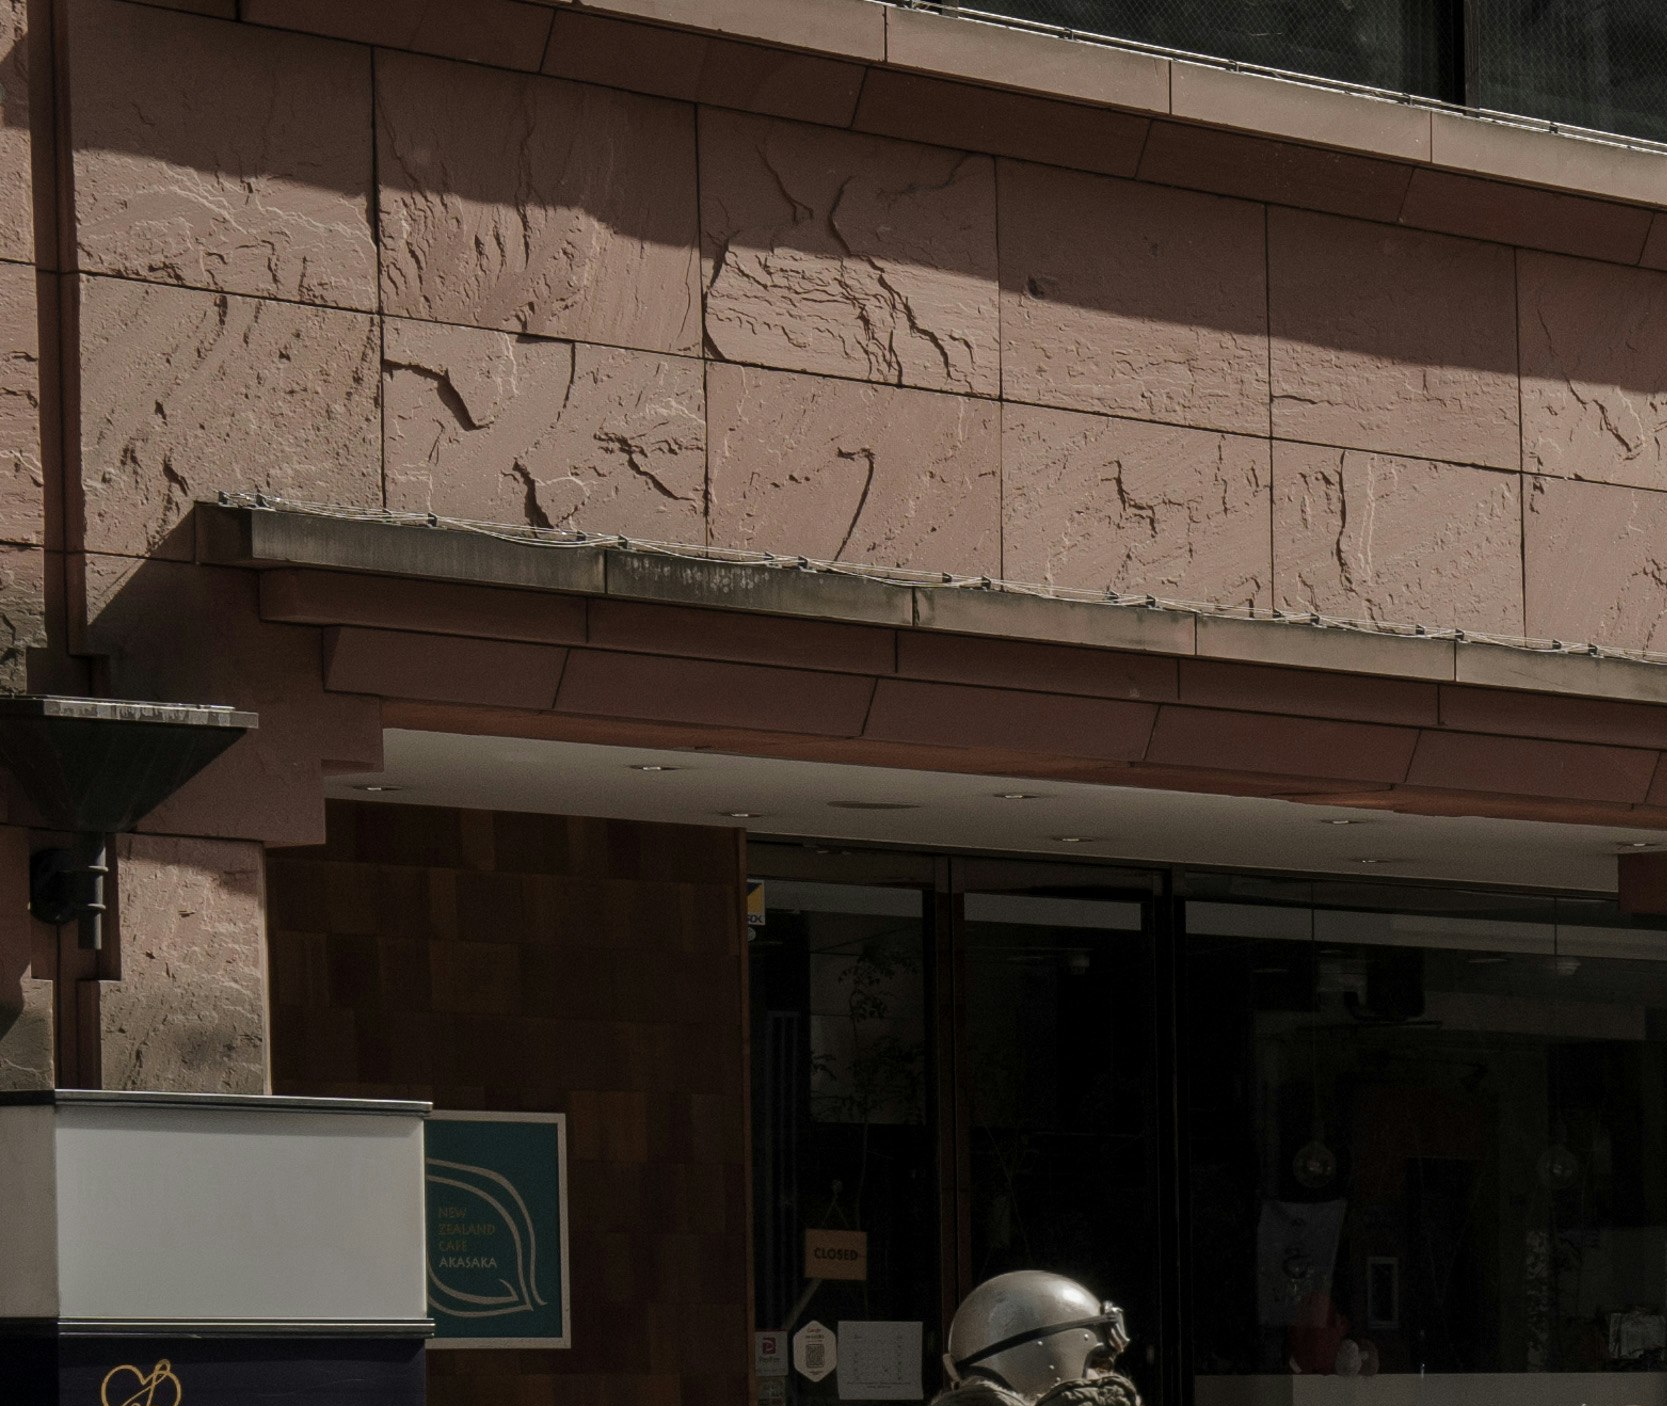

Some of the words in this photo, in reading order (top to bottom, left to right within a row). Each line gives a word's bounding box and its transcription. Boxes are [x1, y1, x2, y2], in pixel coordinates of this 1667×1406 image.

[438, 1206, 467, 1218] NEW
[438, 1223, 496, 1236] ZEALAND
[814, 1247, 859, 1261] CLOSED
[439, 1256, 498, 1269] AKASAKA
